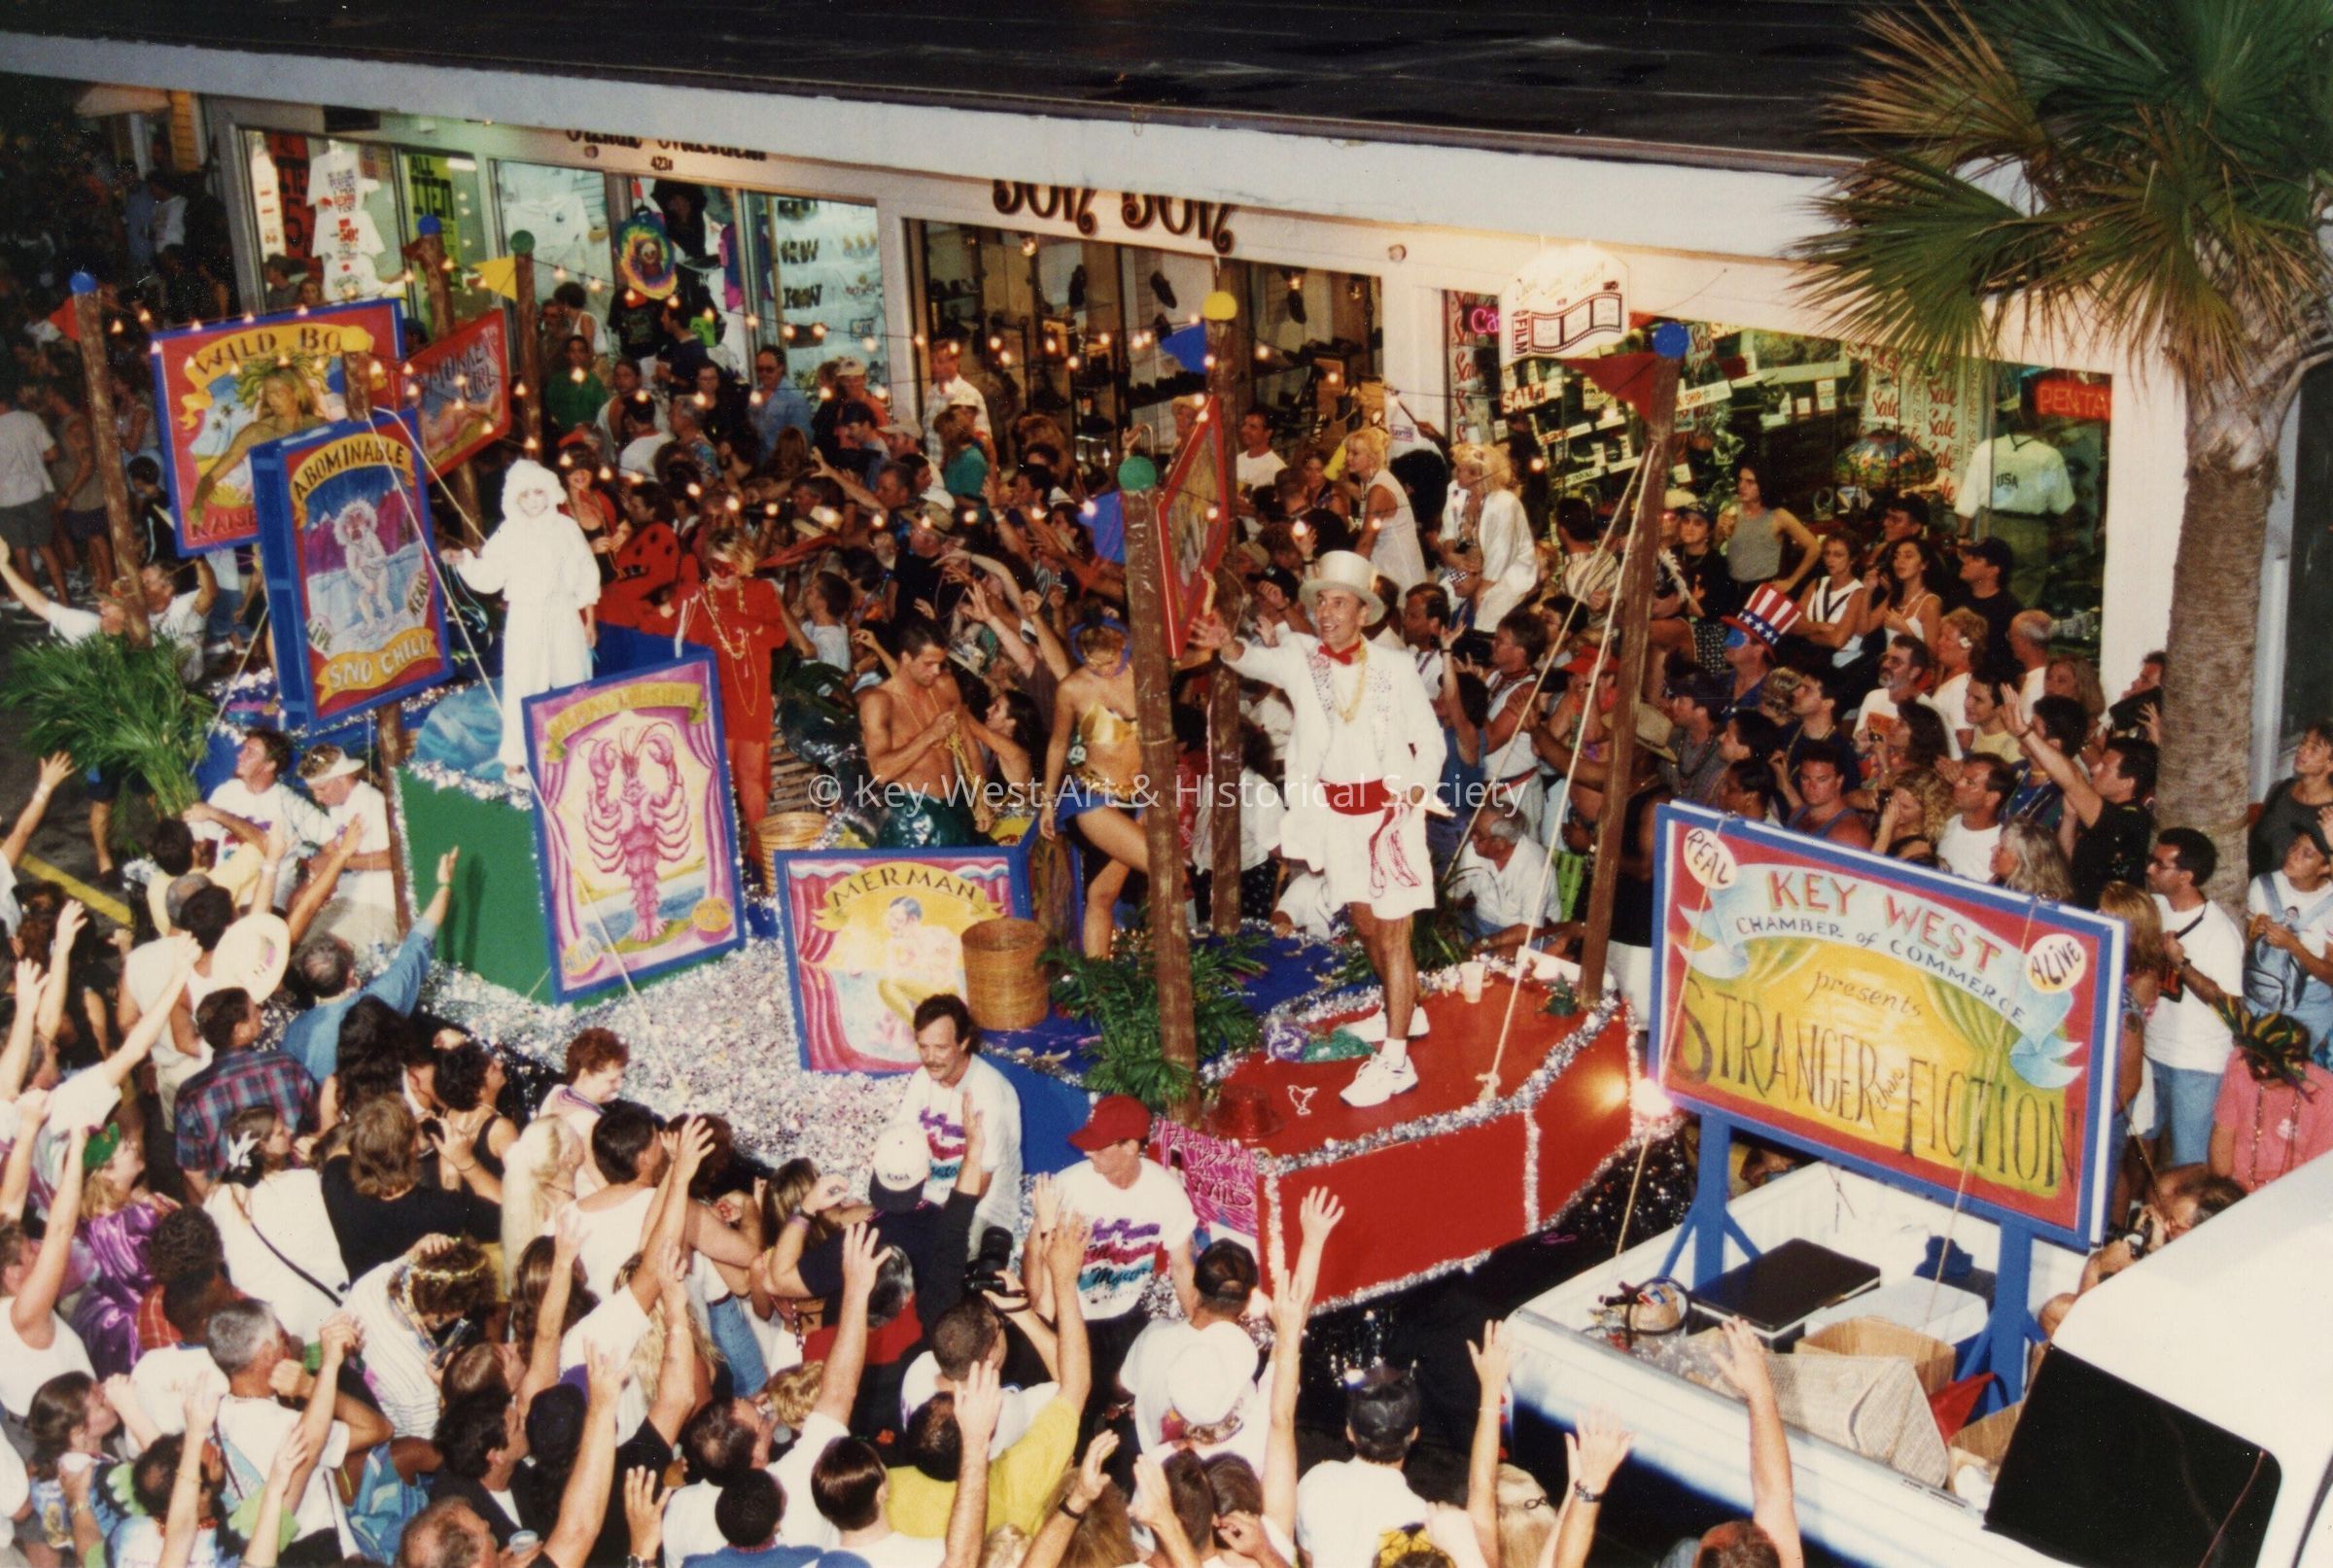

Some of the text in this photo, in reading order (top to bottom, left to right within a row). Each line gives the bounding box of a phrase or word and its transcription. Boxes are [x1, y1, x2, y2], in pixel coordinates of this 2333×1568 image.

[195, 328, 341, 375] WILD BO
[1515, 318, 1528, 355] FILM
[294, 440, 404, 501] ABOMINABLE
[1996, 472, 2019, 488] USA
[329, 634, 431, 688] SNO CHILD
[1687, 829, 1730, 885] REAL
[832, 867, 977, 908] MERMAN
[1768, 871, 2002, 973] KEY WEST
[1735, 916, 2024, 1025] CHAMBER of COMMERCE
[1804, 970, 1923, 1018] presents
[1672, 976, 2079, 1190] STRANGER than FICTION
